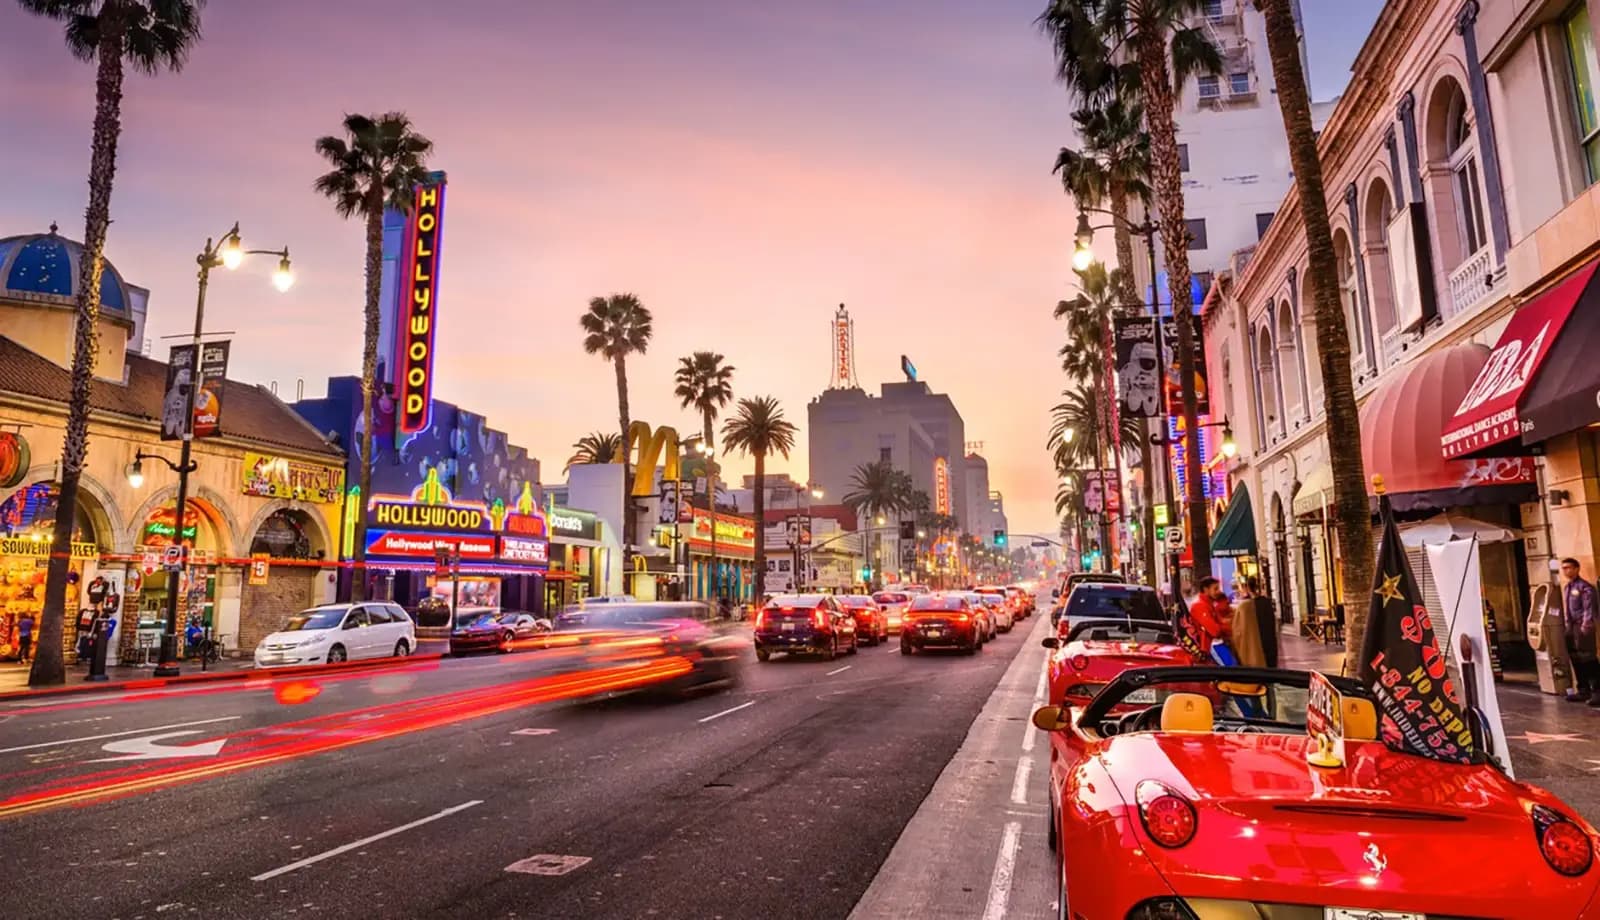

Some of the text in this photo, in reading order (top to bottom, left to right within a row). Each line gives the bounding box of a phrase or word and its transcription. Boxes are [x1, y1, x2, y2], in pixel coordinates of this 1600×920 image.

[406, 189, 436, 414] HOLLYWOOD
[1442, 419, 1520, 457] HOLLYWOOD
[377, 504, 481, 529] HOLLYWOOD
[2, 540, 96, 556] SOUVENI TLET
[386, 538, 434, 551] Hollywood
[459, 541, 491, 553] useum
[1407, 666, 1432, 694] NO
